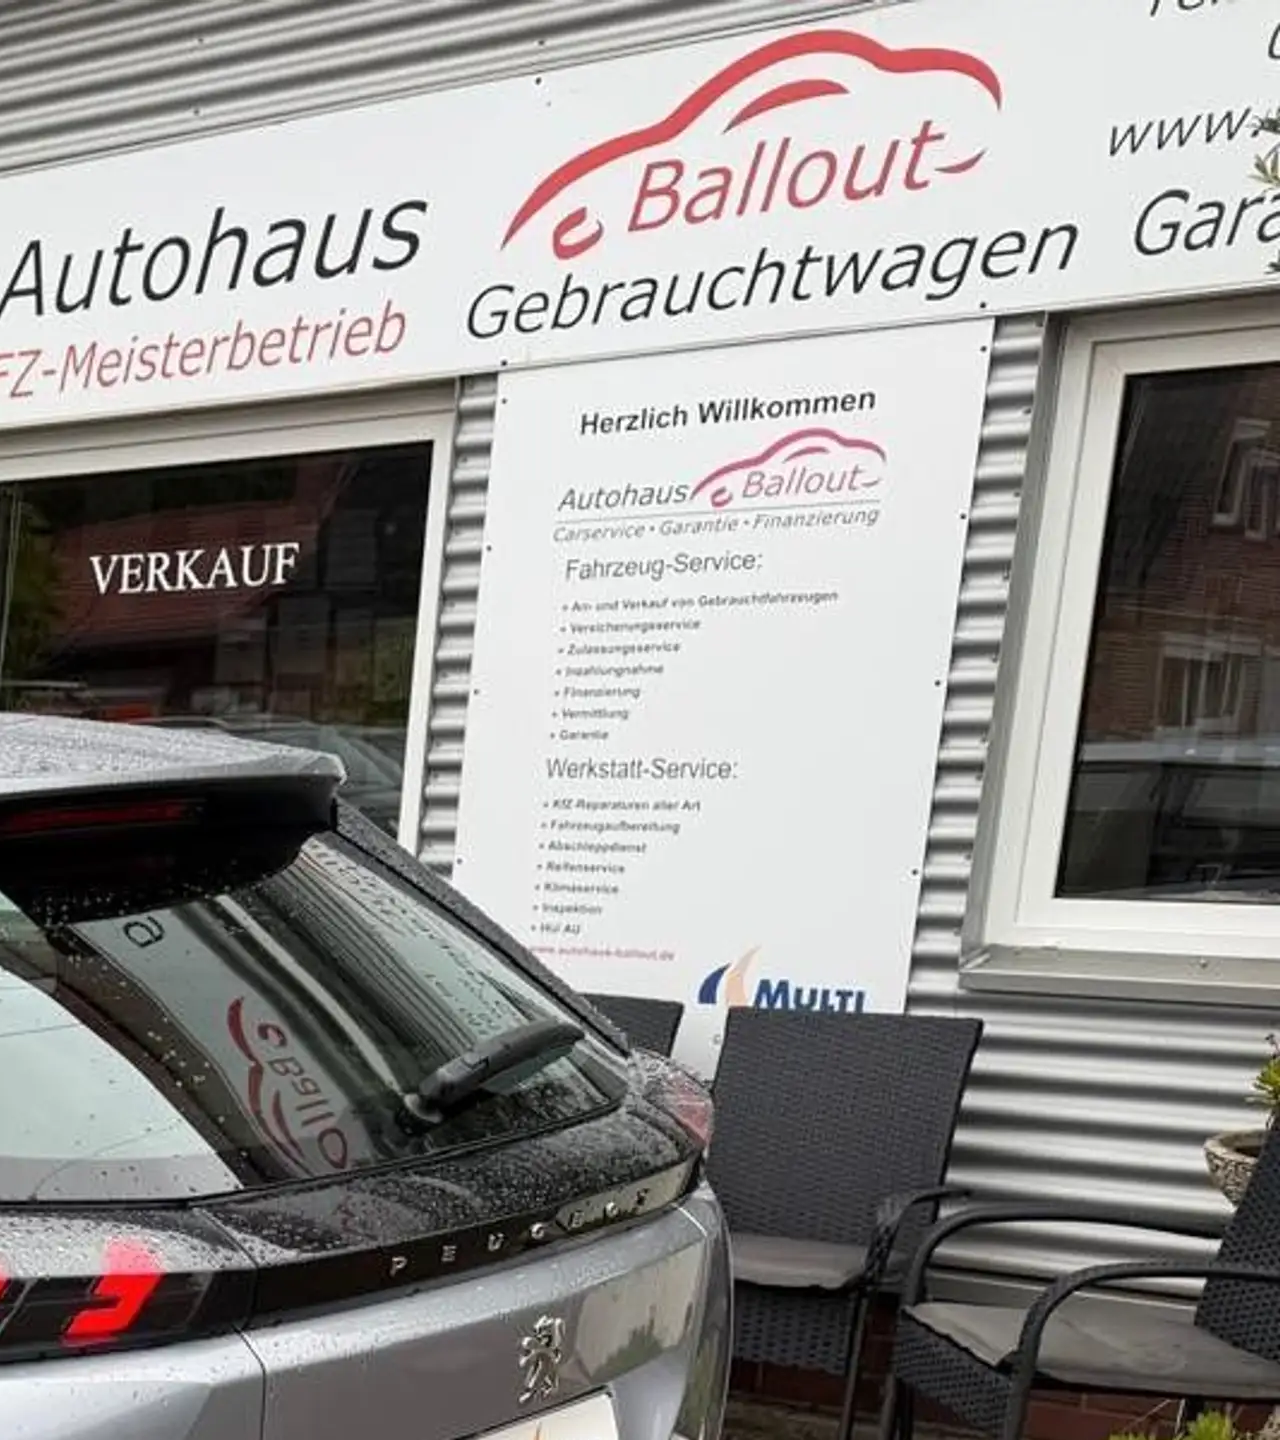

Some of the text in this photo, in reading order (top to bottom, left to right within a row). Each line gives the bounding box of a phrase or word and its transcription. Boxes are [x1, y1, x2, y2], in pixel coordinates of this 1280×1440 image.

[627, 120, 945, 235] Ballout
[466, 221, 1079, 340] Gebrauchtwagen
[580, 389, 877, 435] Herzlich Willkommen
[557, 463, 864, 512] Autohaus Ballout
[553, 507, 880, 543] Carservice Garantie Finanzierung
[89, 541, 301, 596] VERKAUF
[565, 551, 764, 582] Fahrzeug-Service:
[622, 597, 669, 611] Verkauf
[563, 686, 641, 699] Finanzierung
[561, 707, 630, 721] Vermittlung
[545, 757, 739, 780] Werkstatt-Service:
[752, 978, 866, 1015] MULTI
